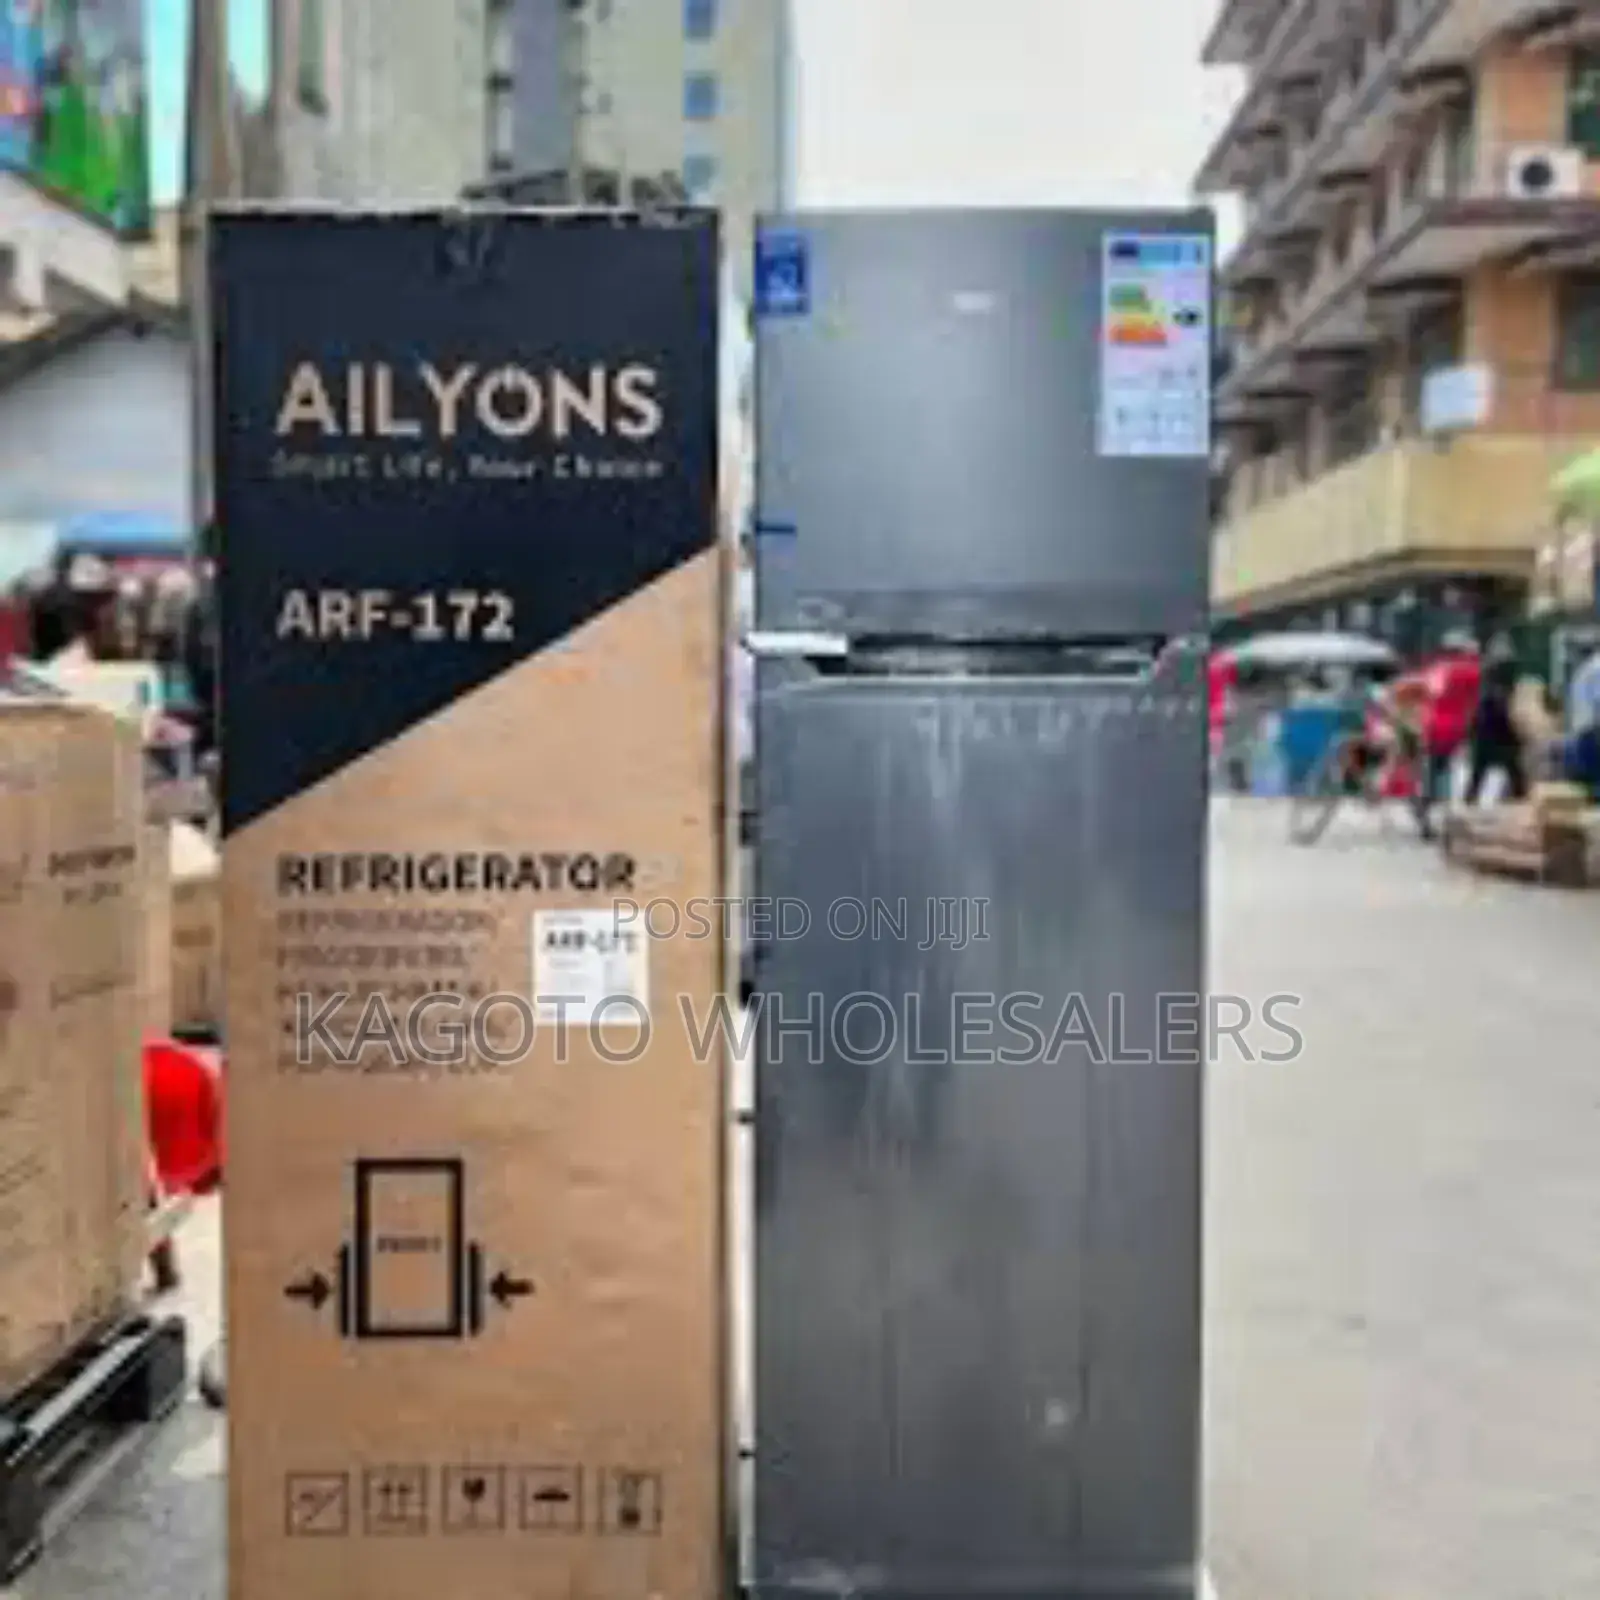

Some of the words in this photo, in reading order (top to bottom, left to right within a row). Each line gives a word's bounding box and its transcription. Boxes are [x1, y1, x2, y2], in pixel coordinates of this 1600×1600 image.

[274, 360, 663, 438] AILYONS
[269, 448, 371, 482] Srt
[467, 452, 535, 479] Yr
[276, 589, 515, 642] ARF-172
[276, 852, 637, 894] REFRIGERATOR
